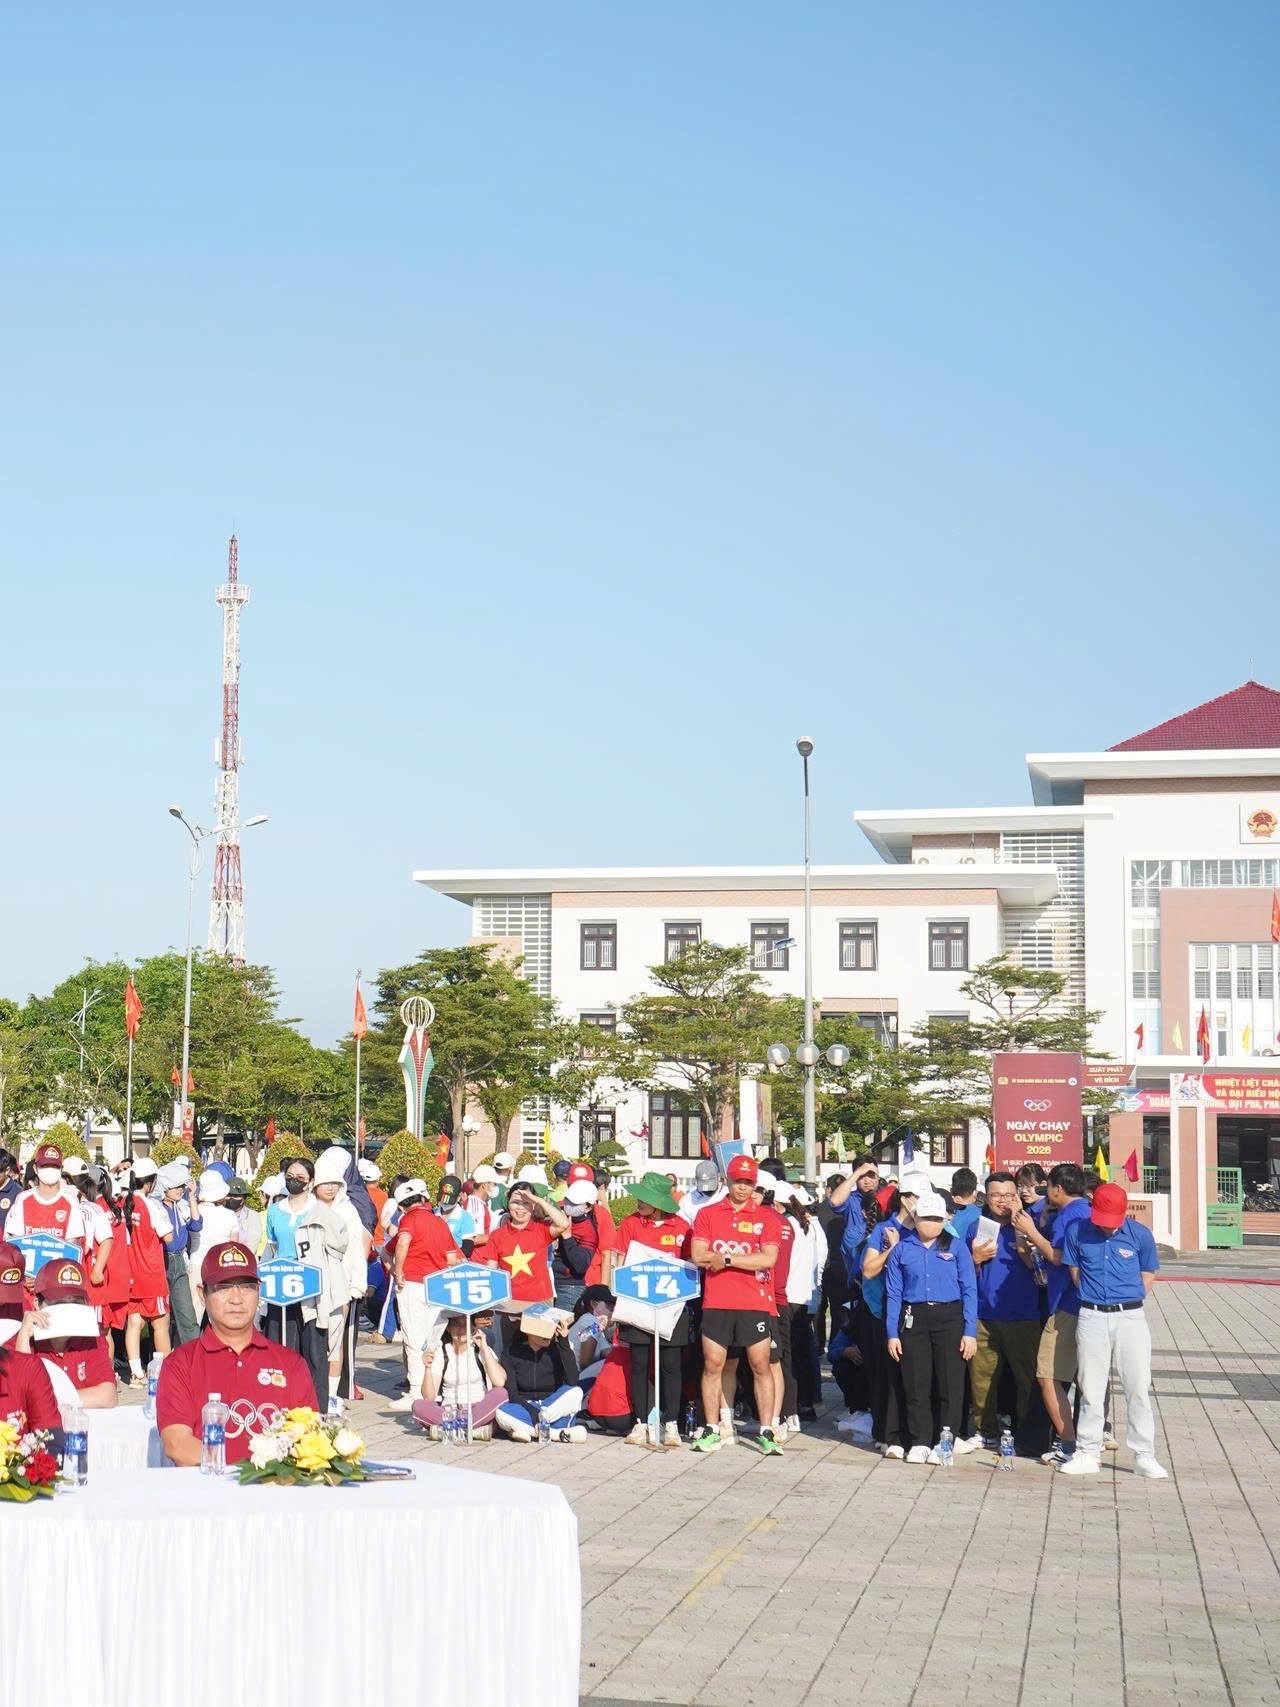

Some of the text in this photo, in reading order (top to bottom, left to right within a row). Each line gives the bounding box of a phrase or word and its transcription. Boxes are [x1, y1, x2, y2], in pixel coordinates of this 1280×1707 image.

[1261, 1078, 1280, 1087] CHÀ
[1006, 1120, 1071, 1132] NGÀY CHẠY
[1014, 1133, 1064, 1142] OLYMPIC
[1026, 1145, 1052, 1154] 2026
[25, 1225, 64, 1237] Emirates
[298, 1241, 311, 1258] P
[260, 1273, 305, 1298] 16
[631, 1274, 681, 1298] 14
[443, 1279, 492, 1305] 15
